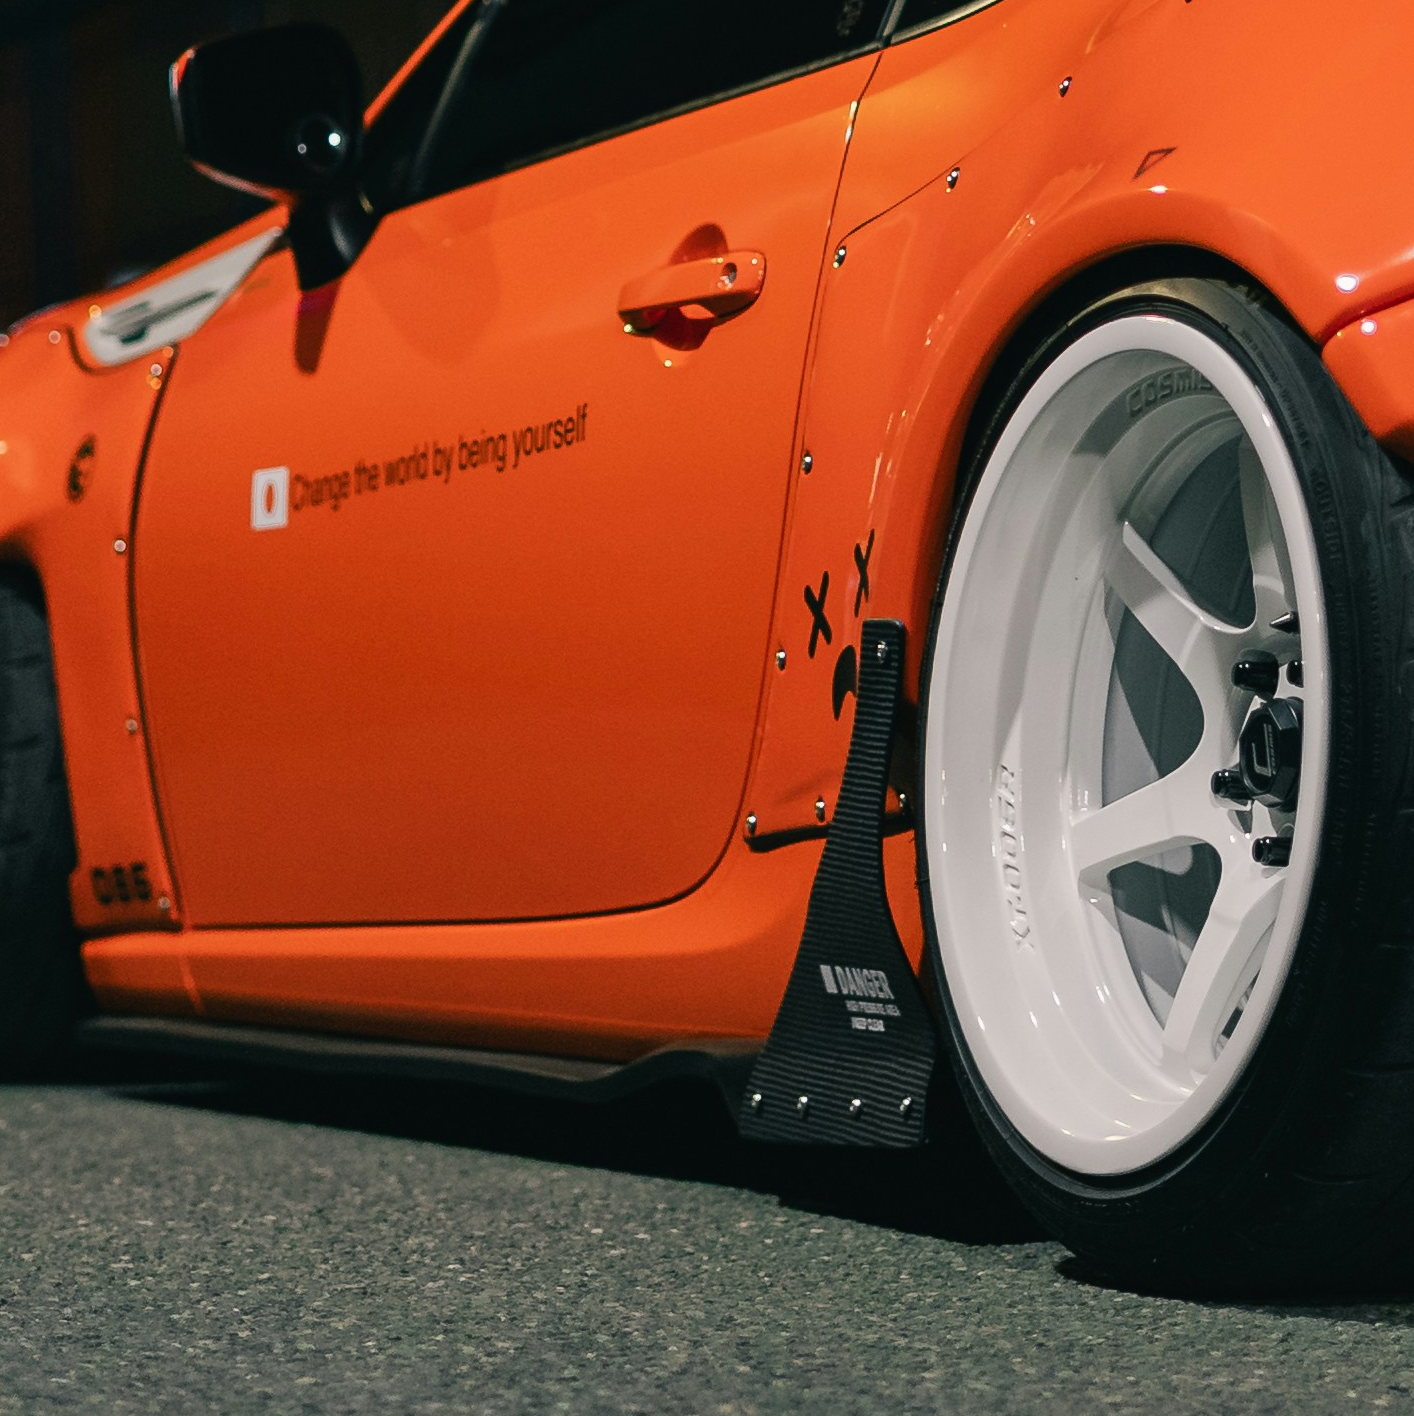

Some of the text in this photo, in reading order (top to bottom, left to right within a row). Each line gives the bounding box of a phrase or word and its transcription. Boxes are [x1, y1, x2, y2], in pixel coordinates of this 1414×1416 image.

[291, 402, 589, 513] Change the world by being yourself
[834, 965, 895, 1000] DANGER
